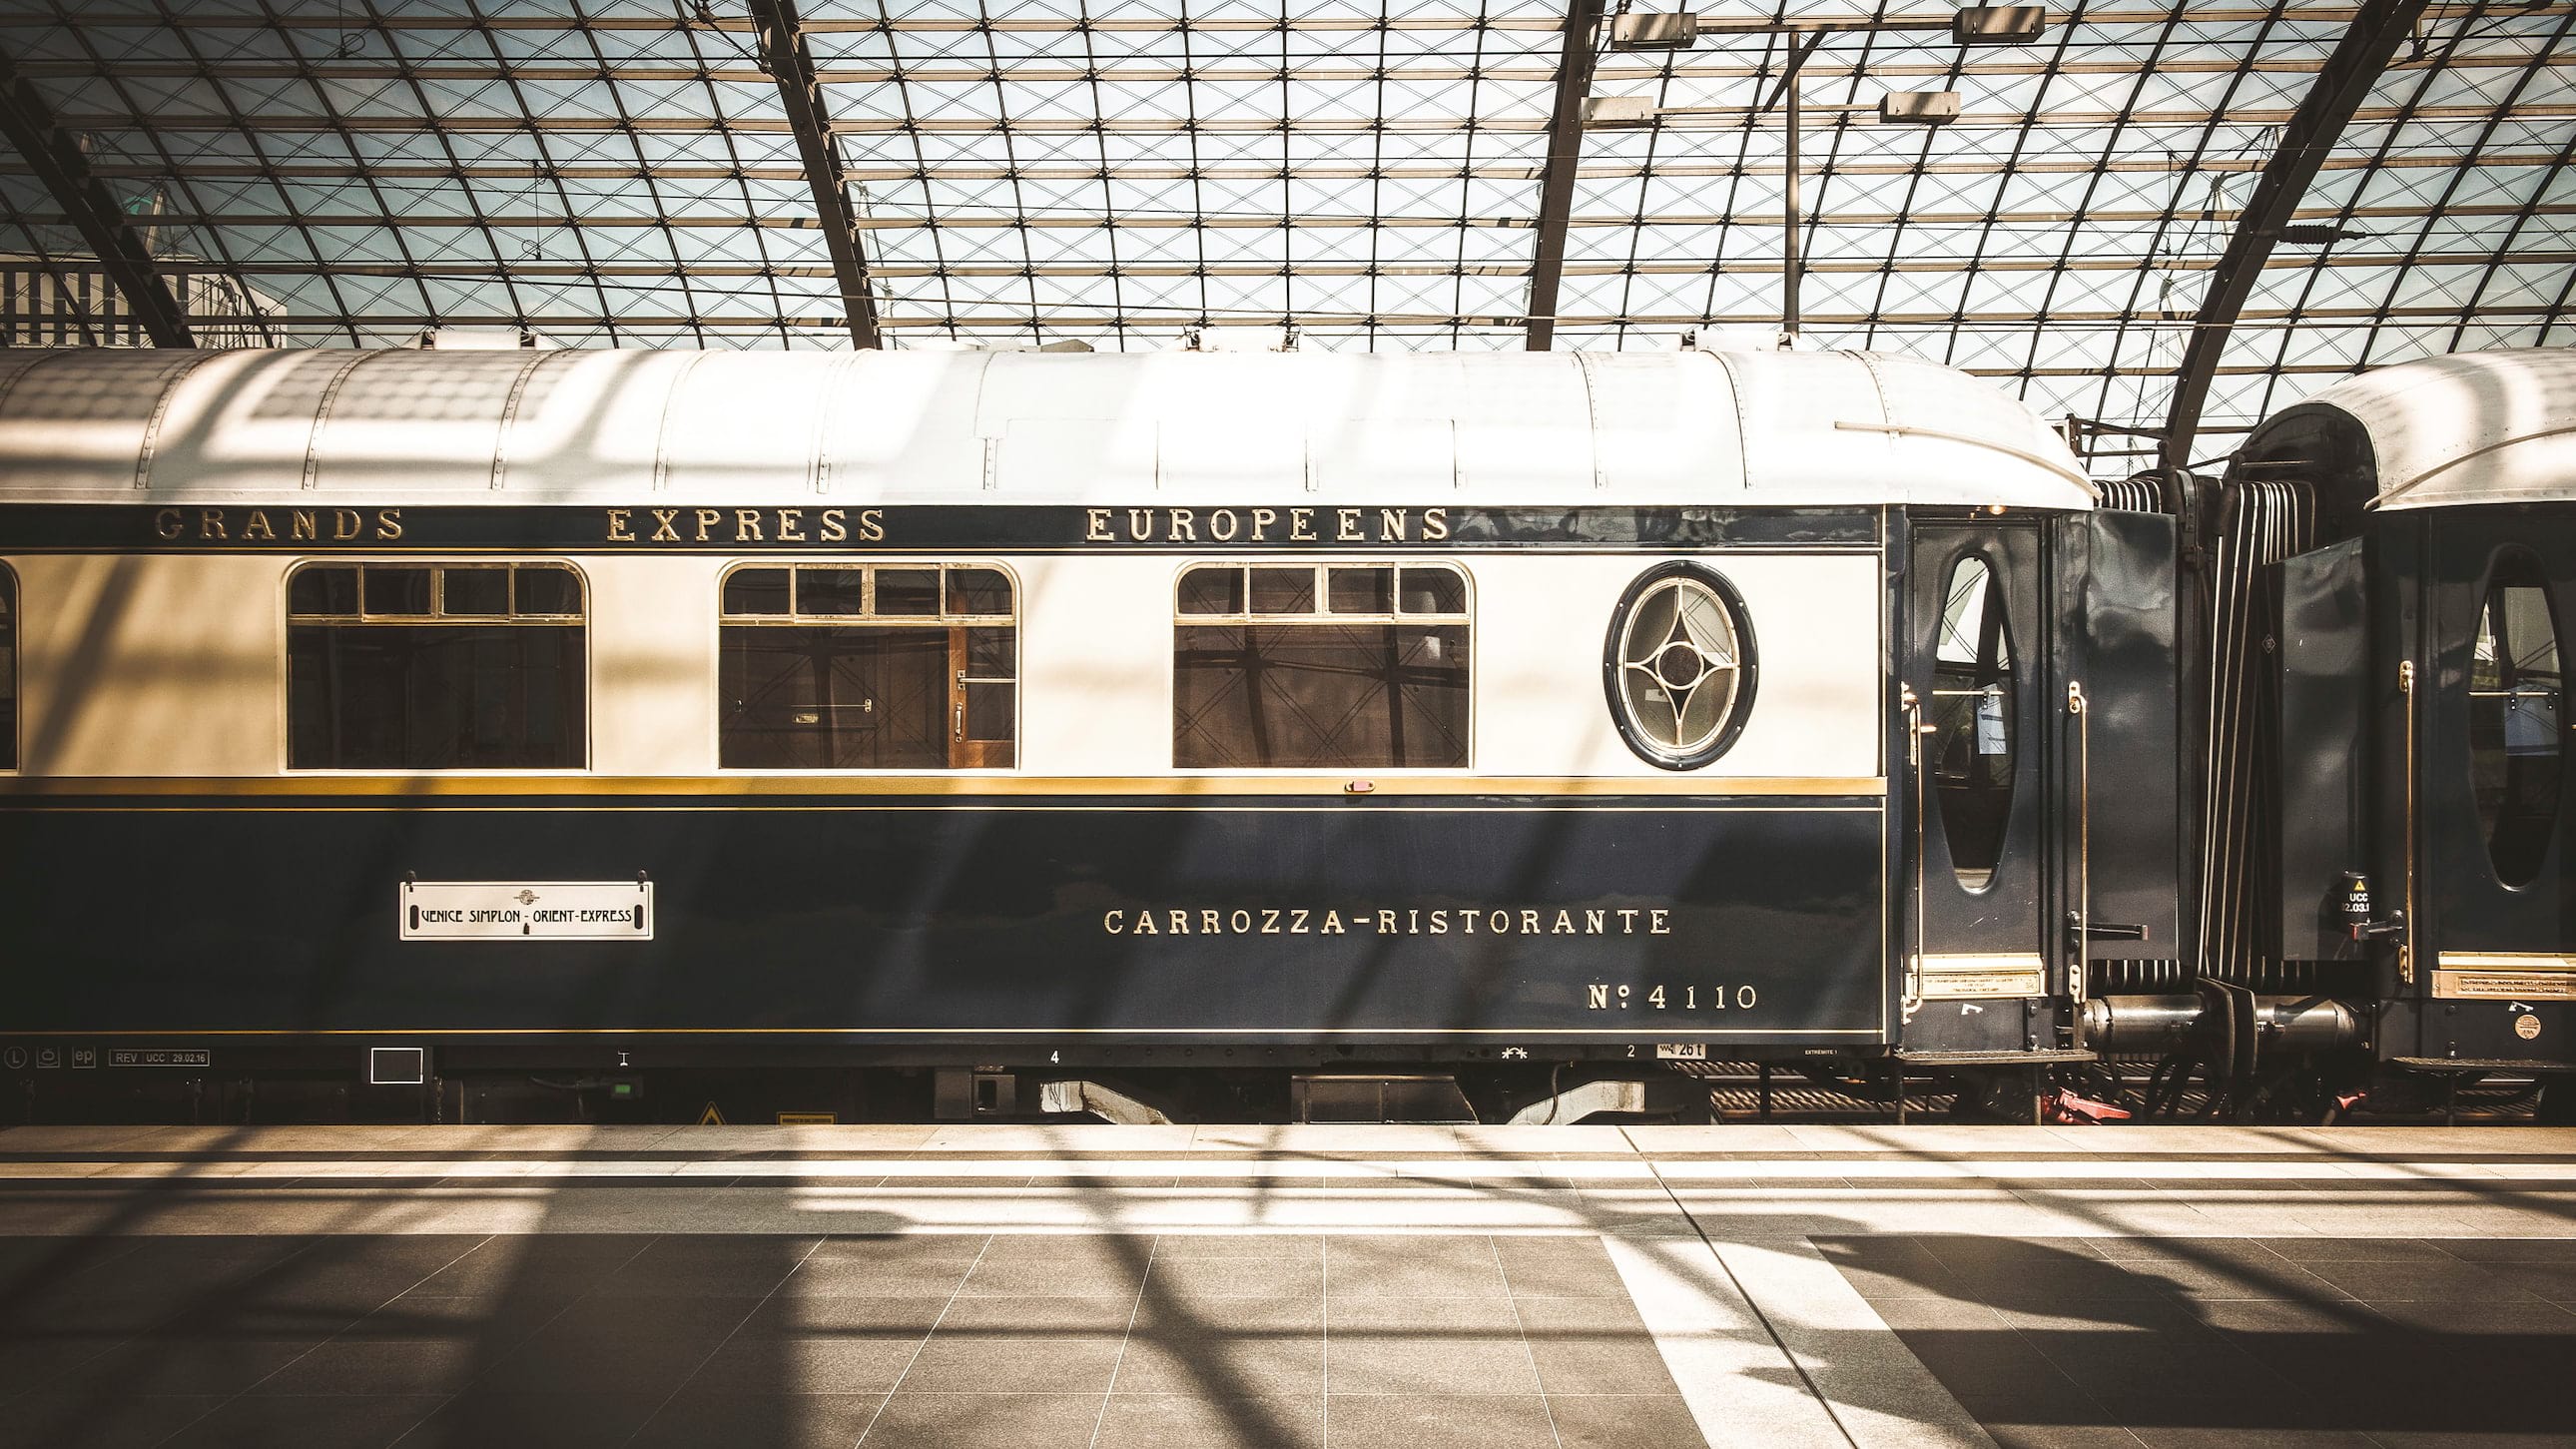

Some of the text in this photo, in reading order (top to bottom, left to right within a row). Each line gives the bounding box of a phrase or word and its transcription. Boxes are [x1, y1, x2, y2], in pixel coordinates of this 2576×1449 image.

[156, 507, 1450, 541] GRANDS EXPRESS EUROPEENS
[2349, 893, 2368, 902] UCC
[421, 910, 463, 923] VENICE
[468, 910, 521, 923] SIMPLON
[532, 910, 632, 923] ORIENT-EXPRESS
[1103, 909, 1672, 936] CARROZZA-RISTORANTE
[1647, 985, 1758, 1010] 4110
[75, 1050, 94, 1065] ep
[1050, 1050, 1060, 1065] 4
[1626, 1045, 1635, 1058] 2
[1678, 1044, 1694, 1057] 26
[116, 1053, 206, 1064] REV UCC 29.02.16
